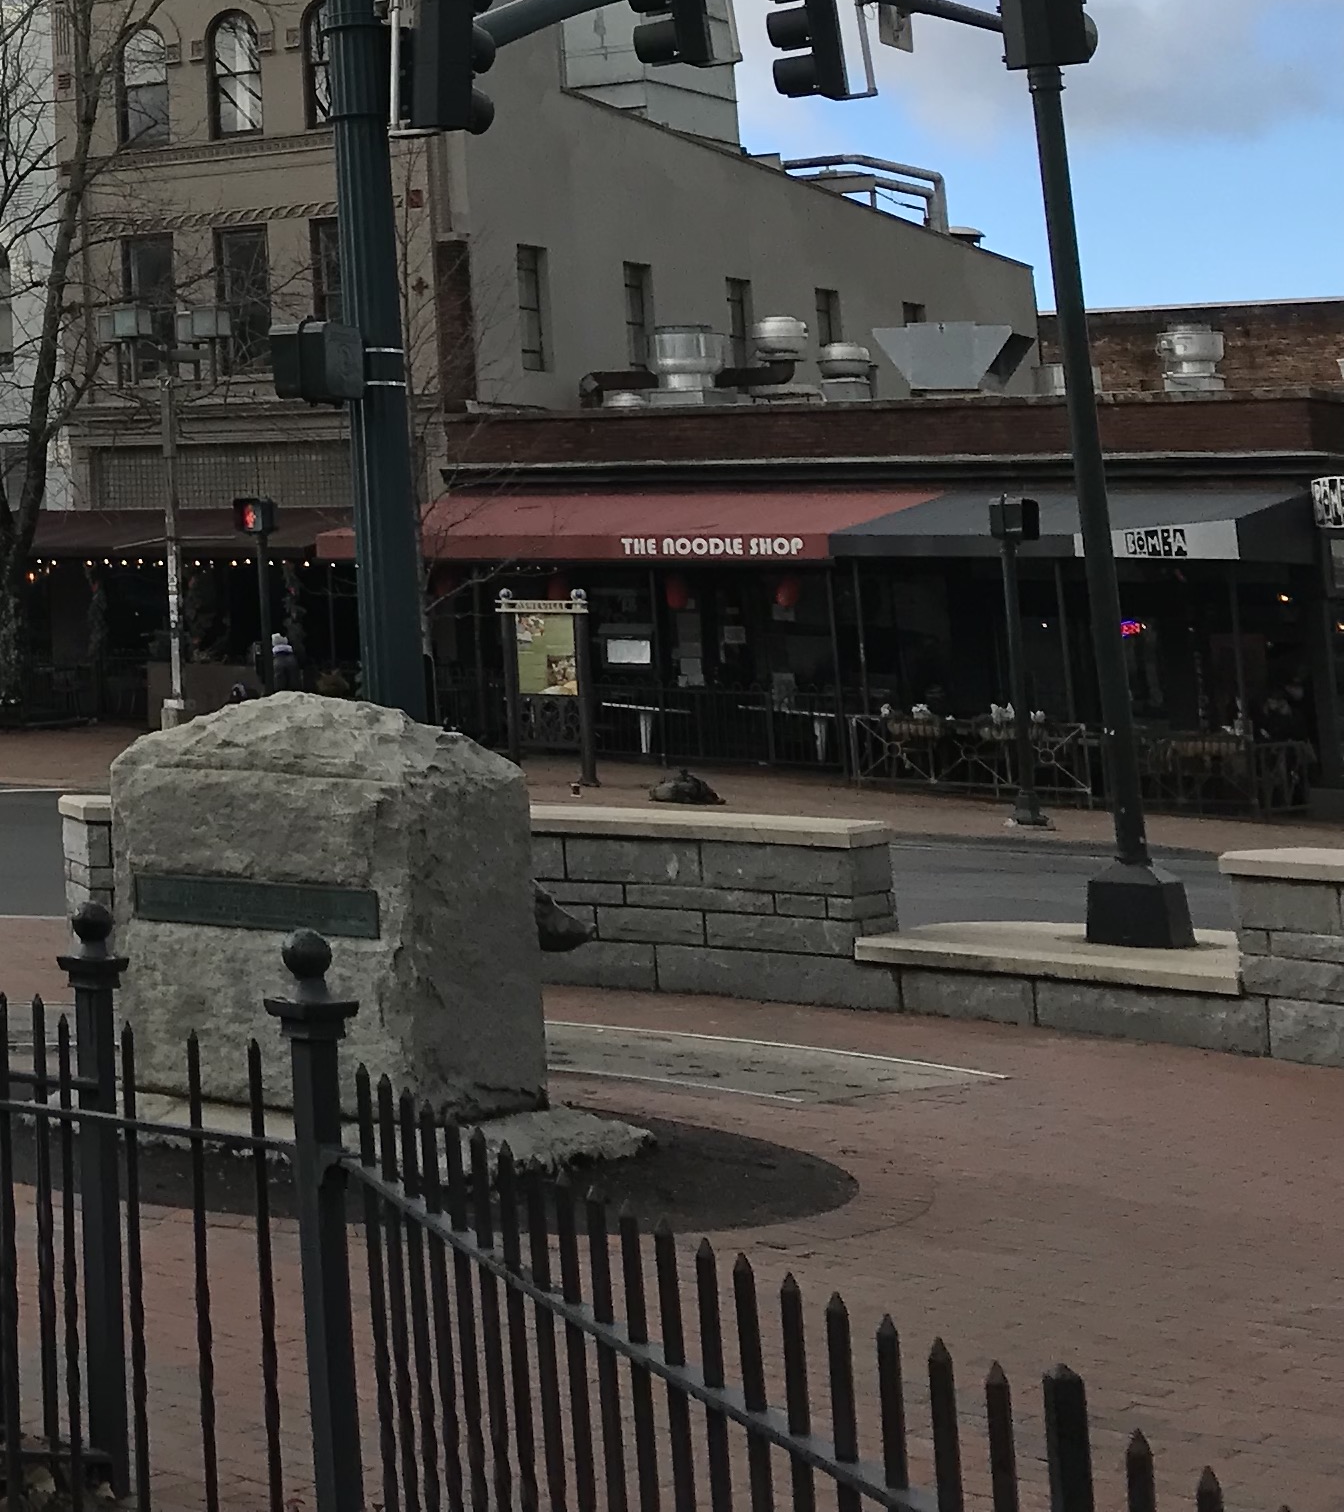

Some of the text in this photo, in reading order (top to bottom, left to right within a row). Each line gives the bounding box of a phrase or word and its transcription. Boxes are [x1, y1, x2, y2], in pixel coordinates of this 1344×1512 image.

[621, 537, 804, 556] THE NOODLE SHOP
[1124, 528, 1188, 557] BOMBA
